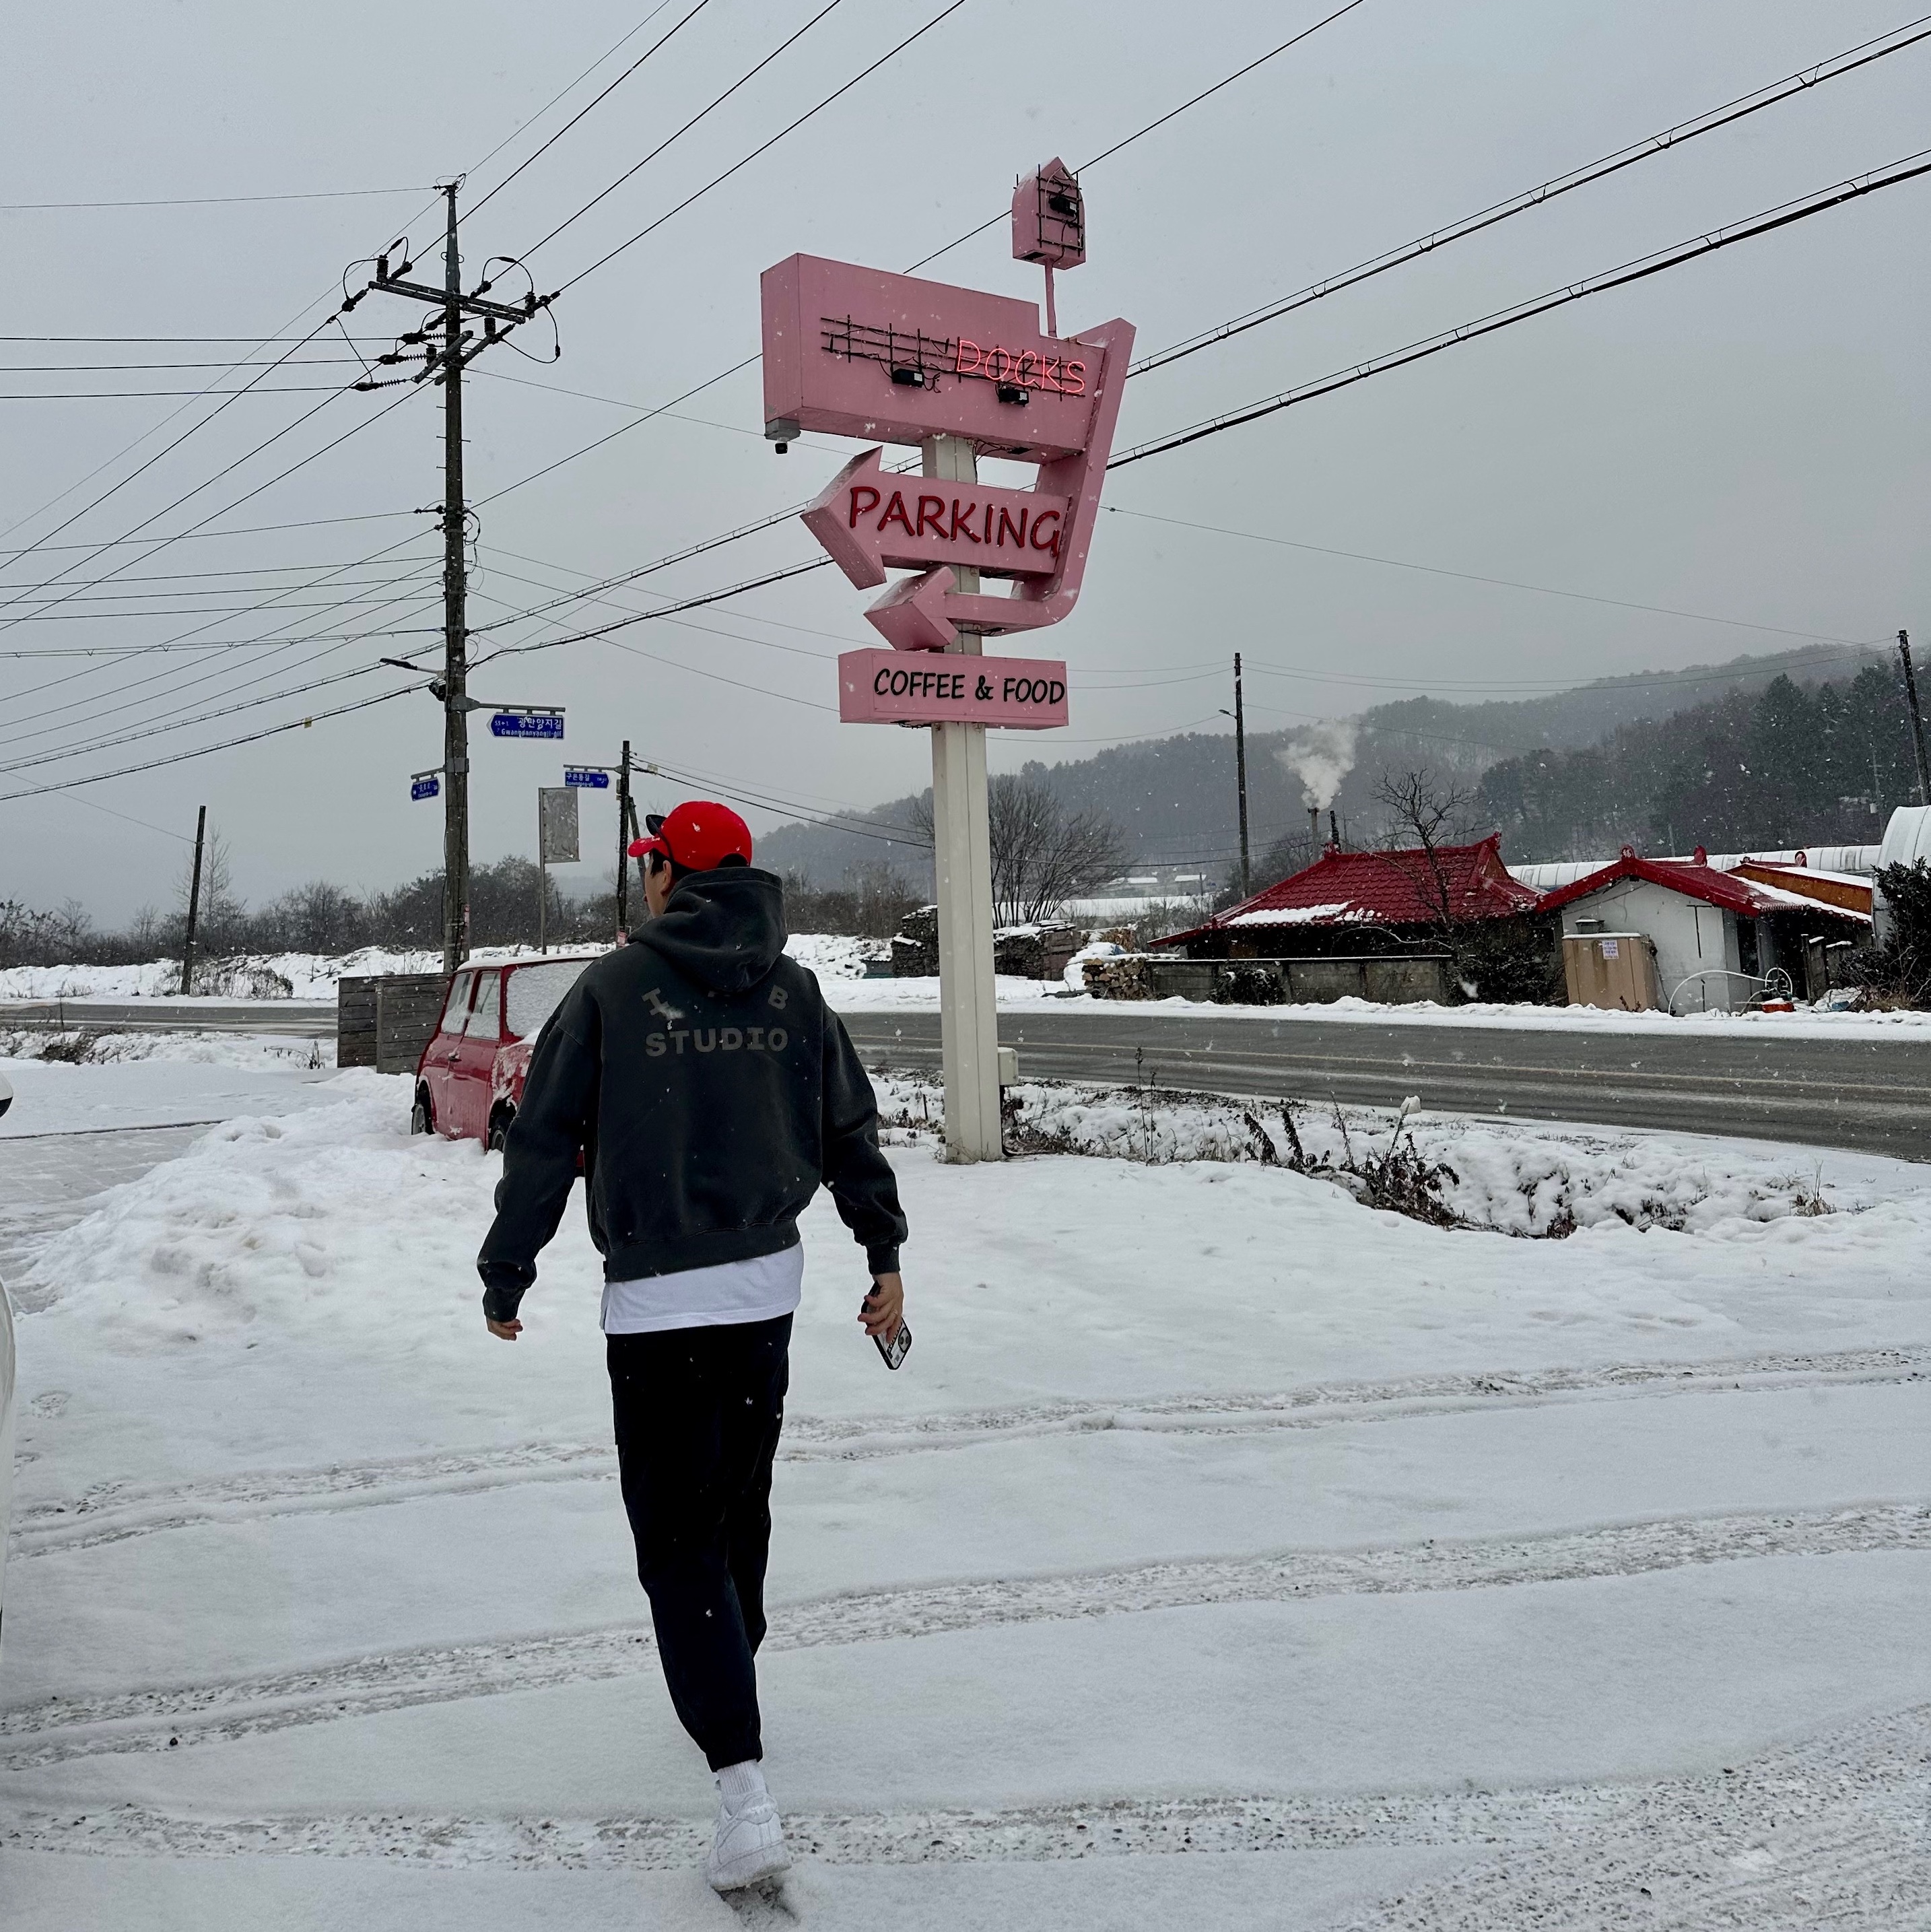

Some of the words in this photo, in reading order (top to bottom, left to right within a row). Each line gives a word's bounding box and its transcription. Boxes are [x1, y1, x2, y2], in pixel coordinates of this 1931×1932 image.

[849, 486, 1060, 558] PARKING
[875, 668, 966, 700] COFFEE
[975, 675, 994, 701] &
[1003, 677, 1065, 704] FOOD
[645, 1026, 788, 1057] STUDIO
